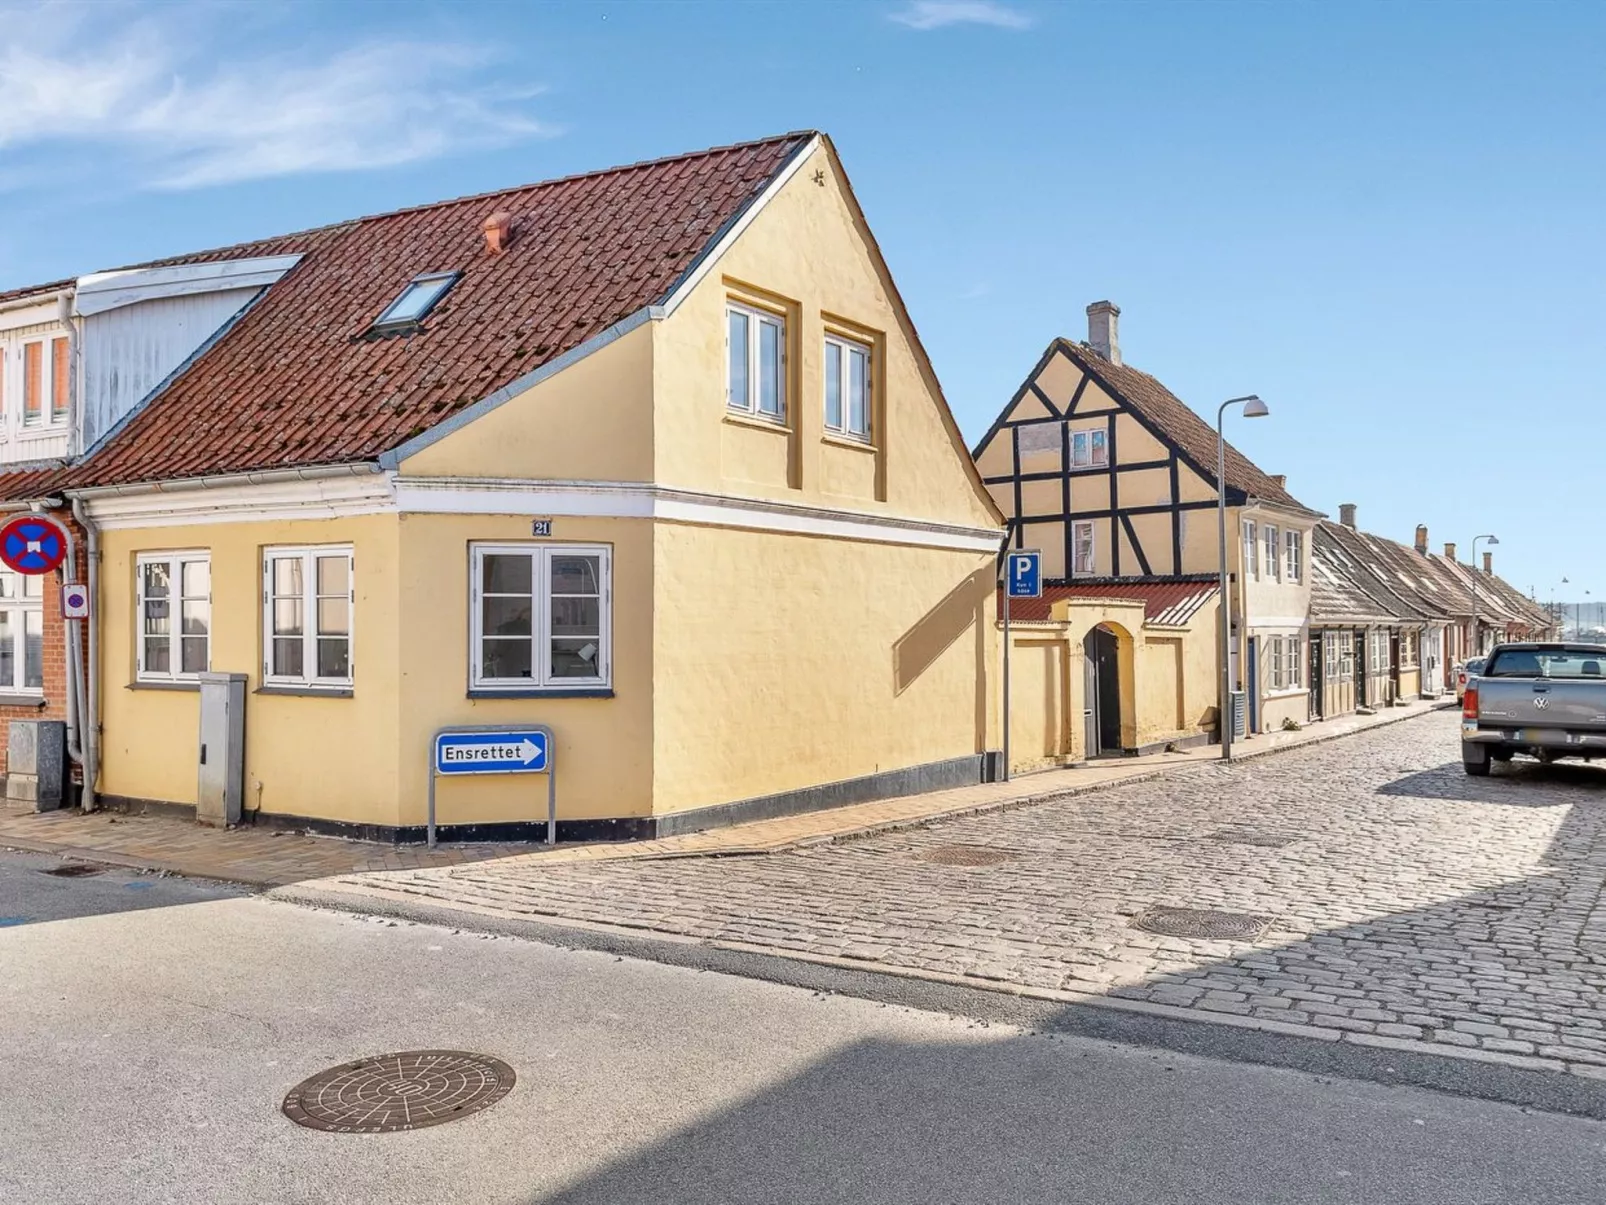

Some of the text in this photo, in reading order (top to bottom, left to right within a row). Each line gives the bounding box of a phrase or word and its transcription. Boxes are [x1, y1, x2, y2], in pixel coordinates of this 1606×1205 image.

[535, 522, 547, 535] 21
[1016, 557, 1032, 580] P
[445, 745, 522, 760] Ensrettet
